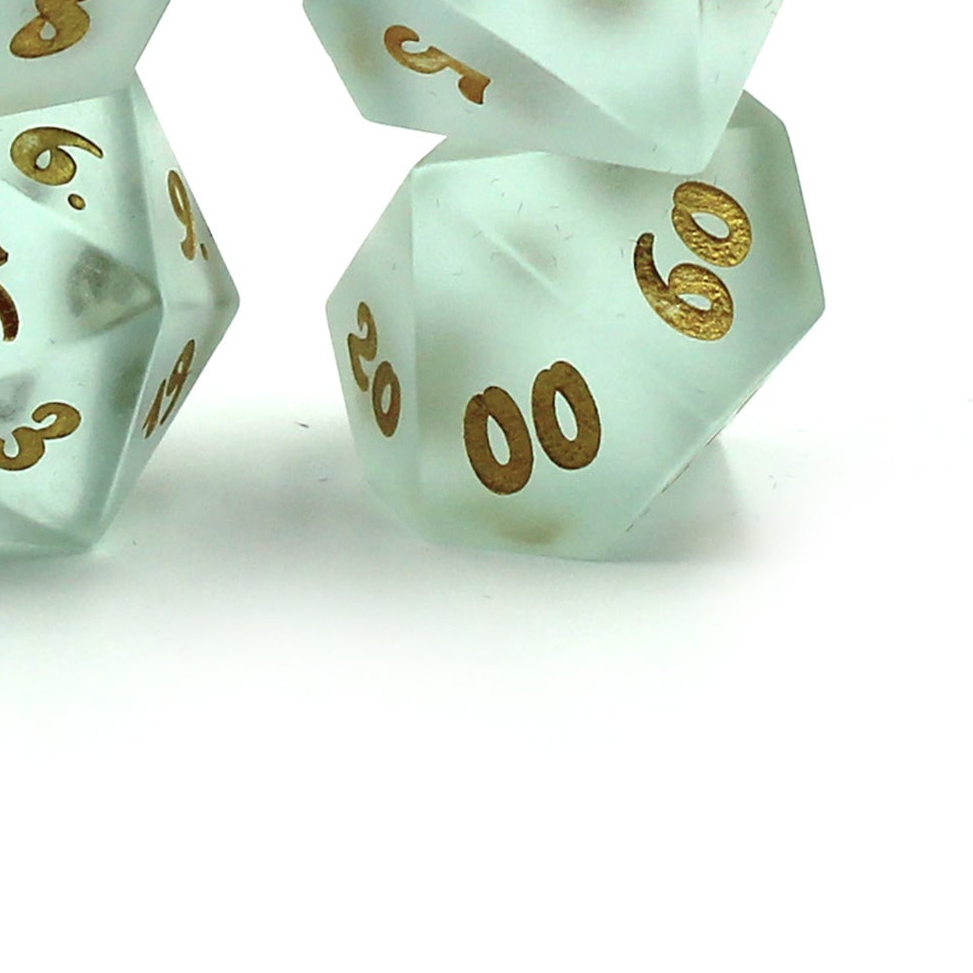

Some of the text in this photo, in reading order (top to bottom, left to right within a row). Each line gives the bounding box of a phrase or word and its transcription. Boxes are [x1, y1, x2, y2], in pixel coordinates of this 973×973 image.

[383, 24, 492, 106] 5
[347, 301, 403, 438] 20
[463, 360, 602, 496] 00
